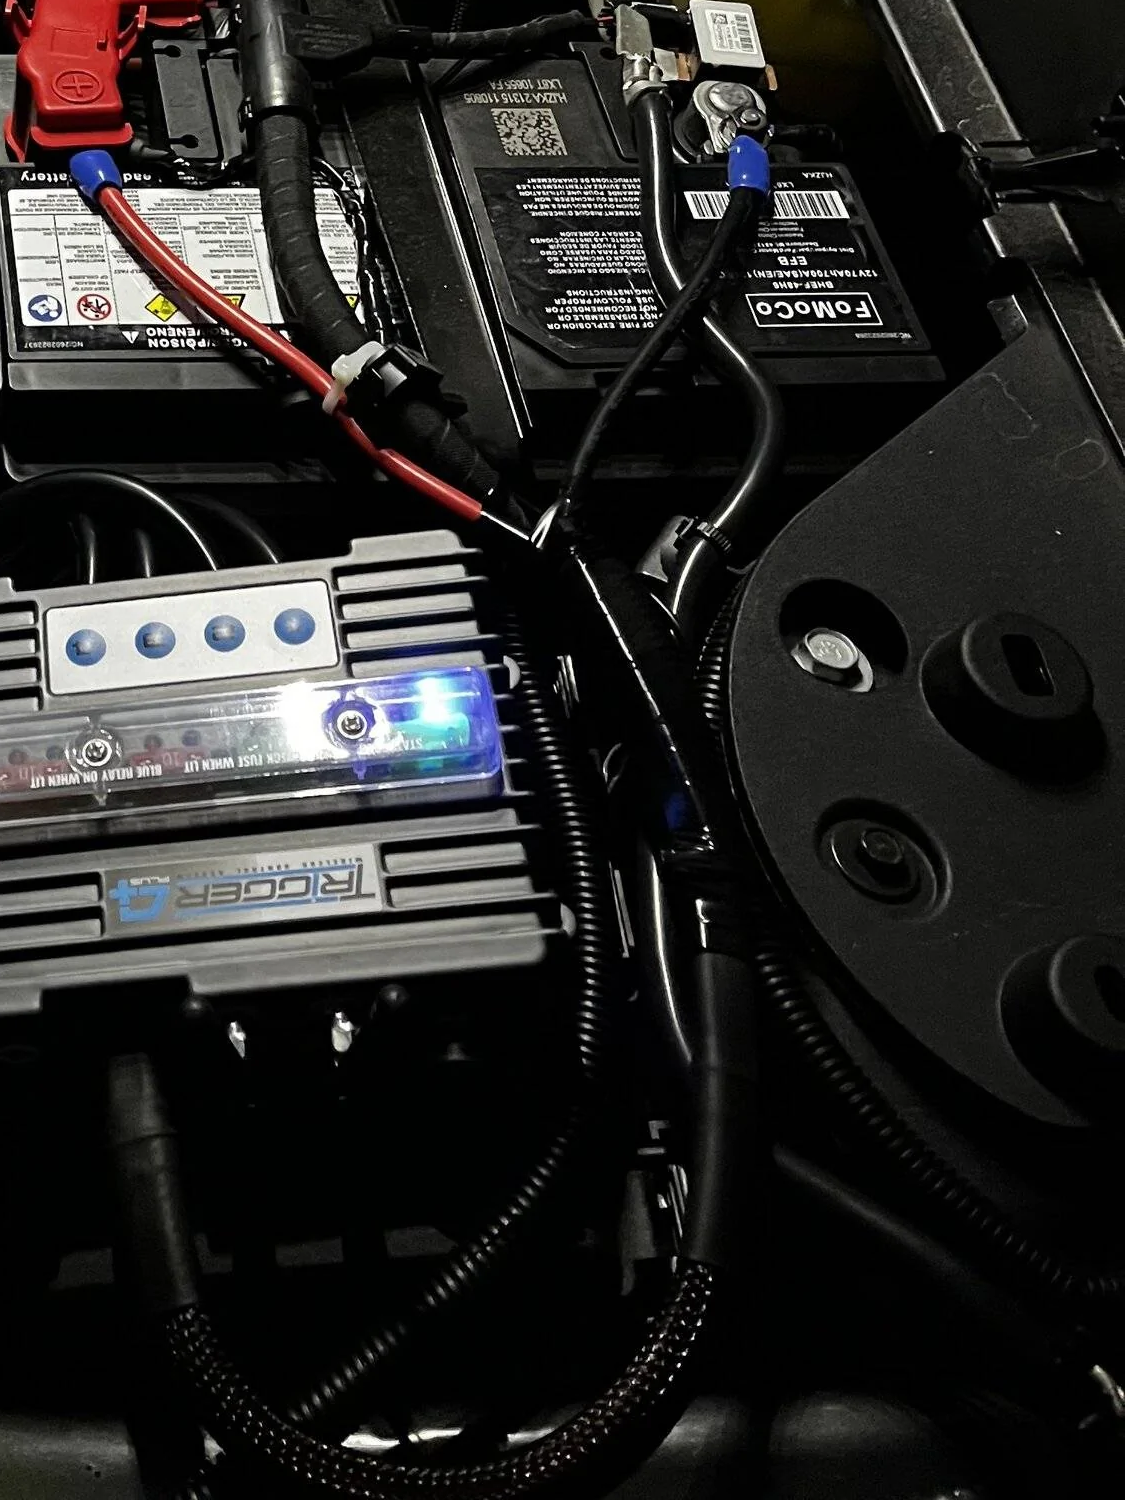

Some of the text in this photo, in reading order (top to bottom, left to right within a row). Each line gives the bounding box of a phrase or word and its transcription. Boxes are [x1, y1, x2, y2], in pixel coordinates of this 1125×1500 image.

[501, 92, 532, 103] 21315
[777, 256, 808, 266] EFB
[756, 300, 872, 319] FoMoCo
[183, 760, 199, 773] LIT
[202, 757, 235, 771] WHEN
[30, 764, 162, 788] BLUE RELAY ON WHEN LIT
